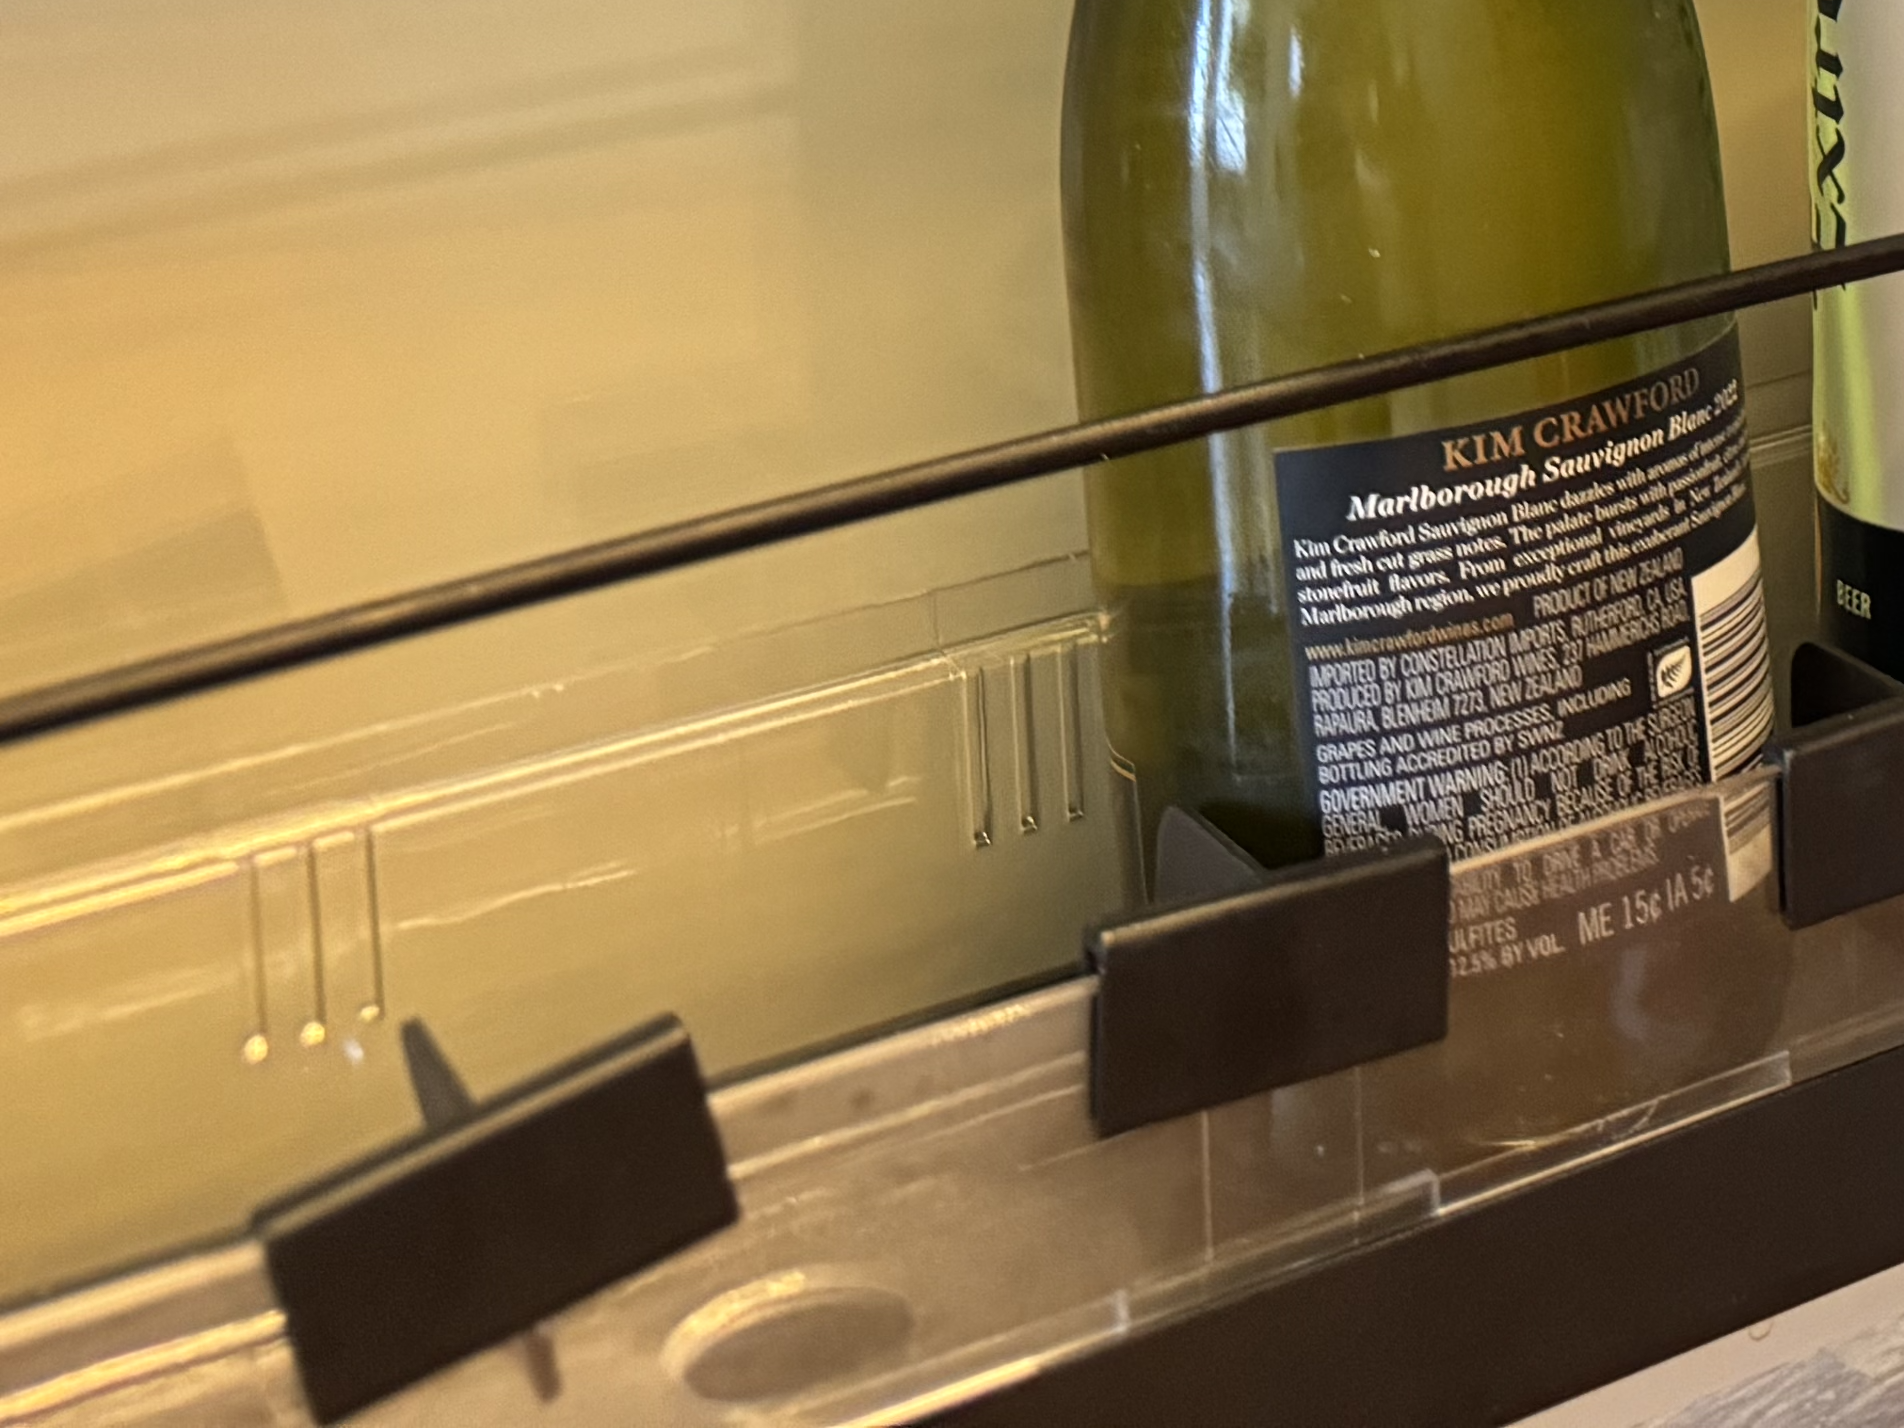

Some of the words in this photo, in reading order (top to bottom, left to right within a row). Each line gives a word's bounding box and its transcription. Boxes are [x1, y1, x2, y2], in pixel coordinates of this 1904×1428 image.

[1441, 425, 1526, 471] KIM
[1533, 367, 1700, 448] CRAWFORD
[1345, 463, 1536, 521] Marlborough
[1542, 427, 1664, 483] Sauvignon
[1668, 405, 1713, 441] Blanc
[1835, 579, 1872, 620] BEER
[1316, 739, 1377, 763] GRAPES
[1379, 733, 1414, 755] AND
[1417, 725, 1462, 748] WINE
[1318, 759, 1392, 785] BOTTLING
[1395, 739, 1491, 774] ACCREDITED
[1319, 778, 1426, 814] GOVERNMENT
[1577, 902, 1615, 945] ME
[1622, 890, 1662, 930] 15¢
[1690, 865, 1715, 900] 5¢
